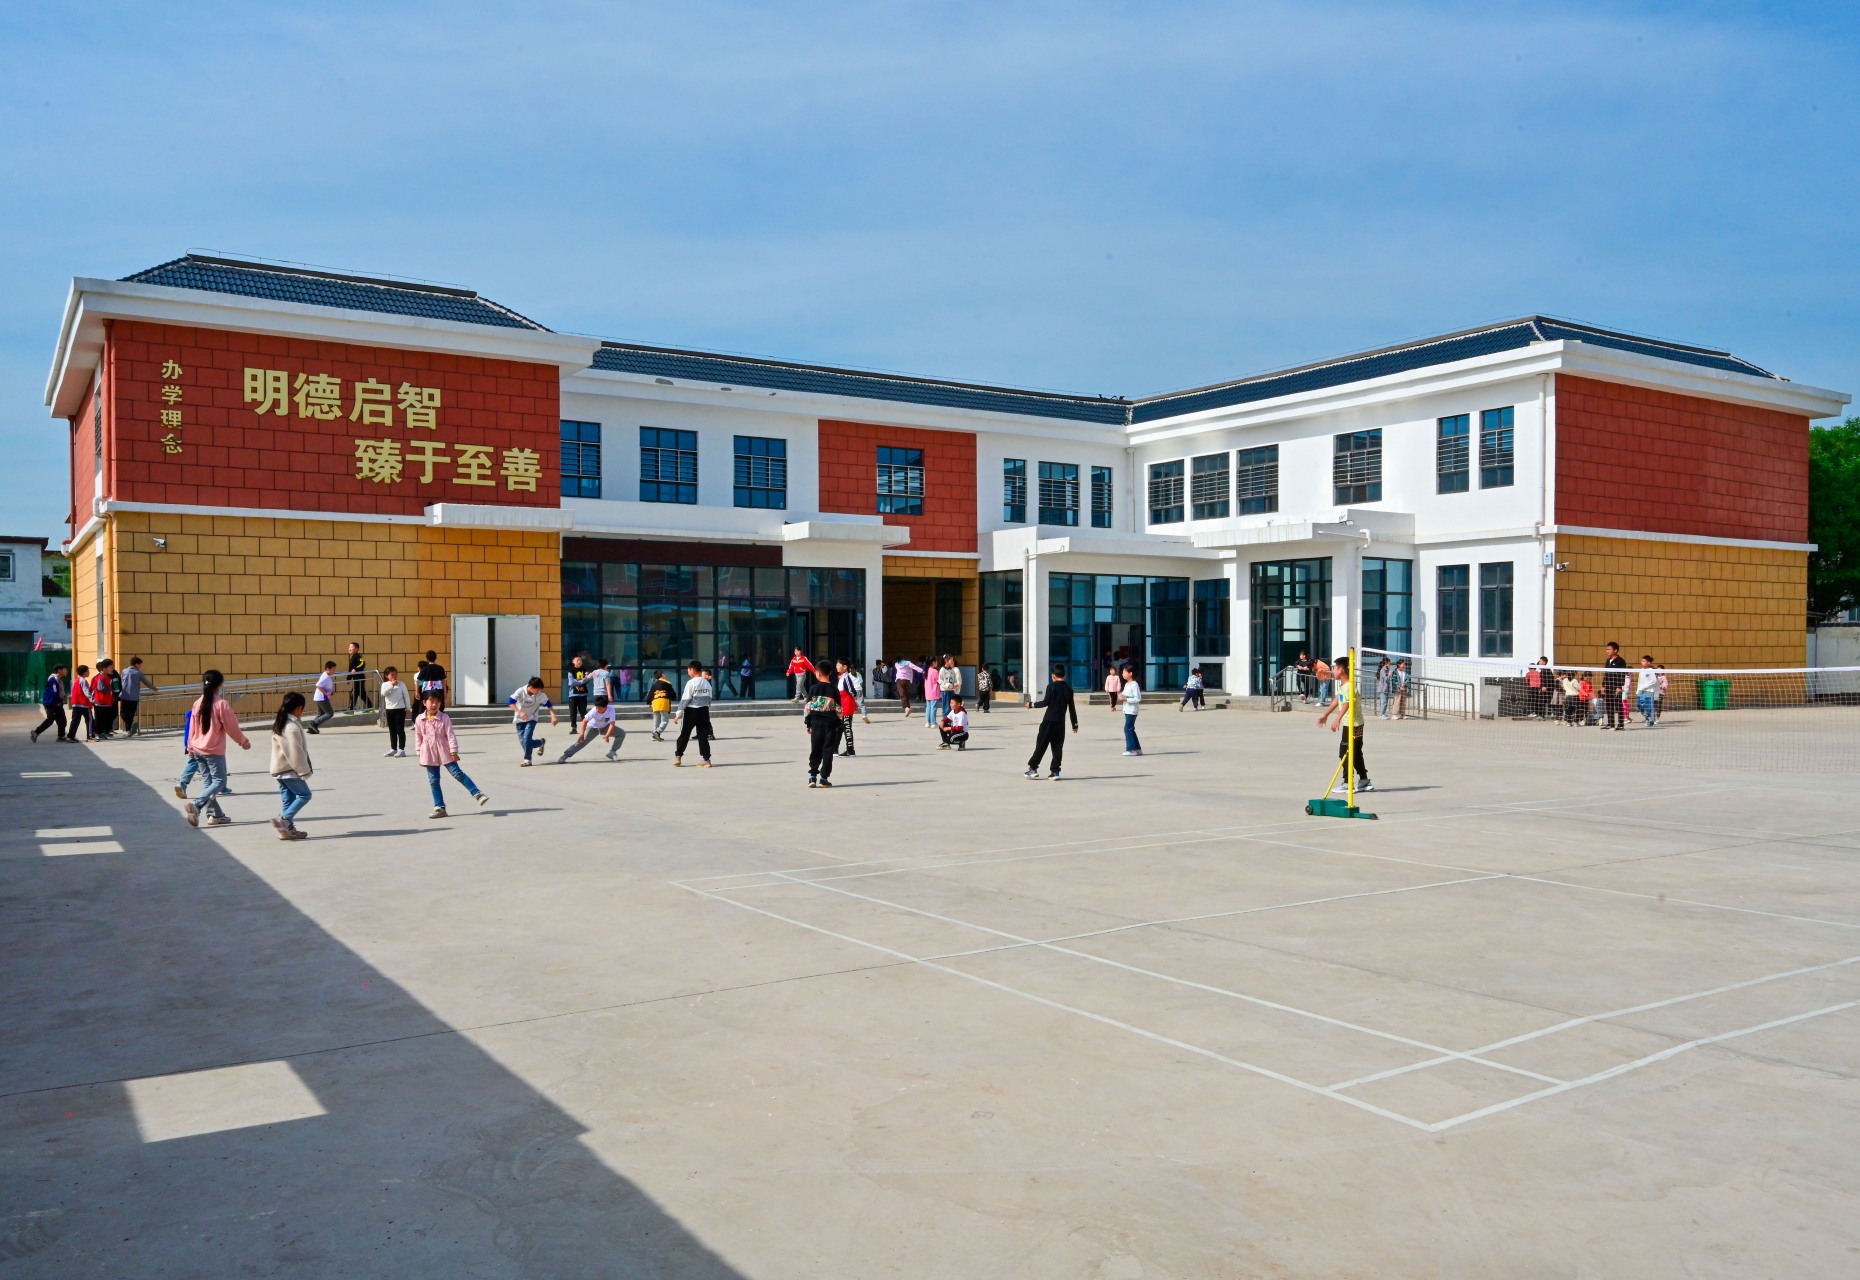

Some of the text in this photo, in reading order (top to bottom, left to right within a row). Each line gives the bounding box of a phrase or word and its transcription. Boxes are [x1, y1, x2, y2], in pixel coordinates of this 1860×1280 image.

[160, 359, 183, 454] 办学理念
[243, 367, 441, 430] 明德启智
[354, 438, 543, 492] 臻于至善
